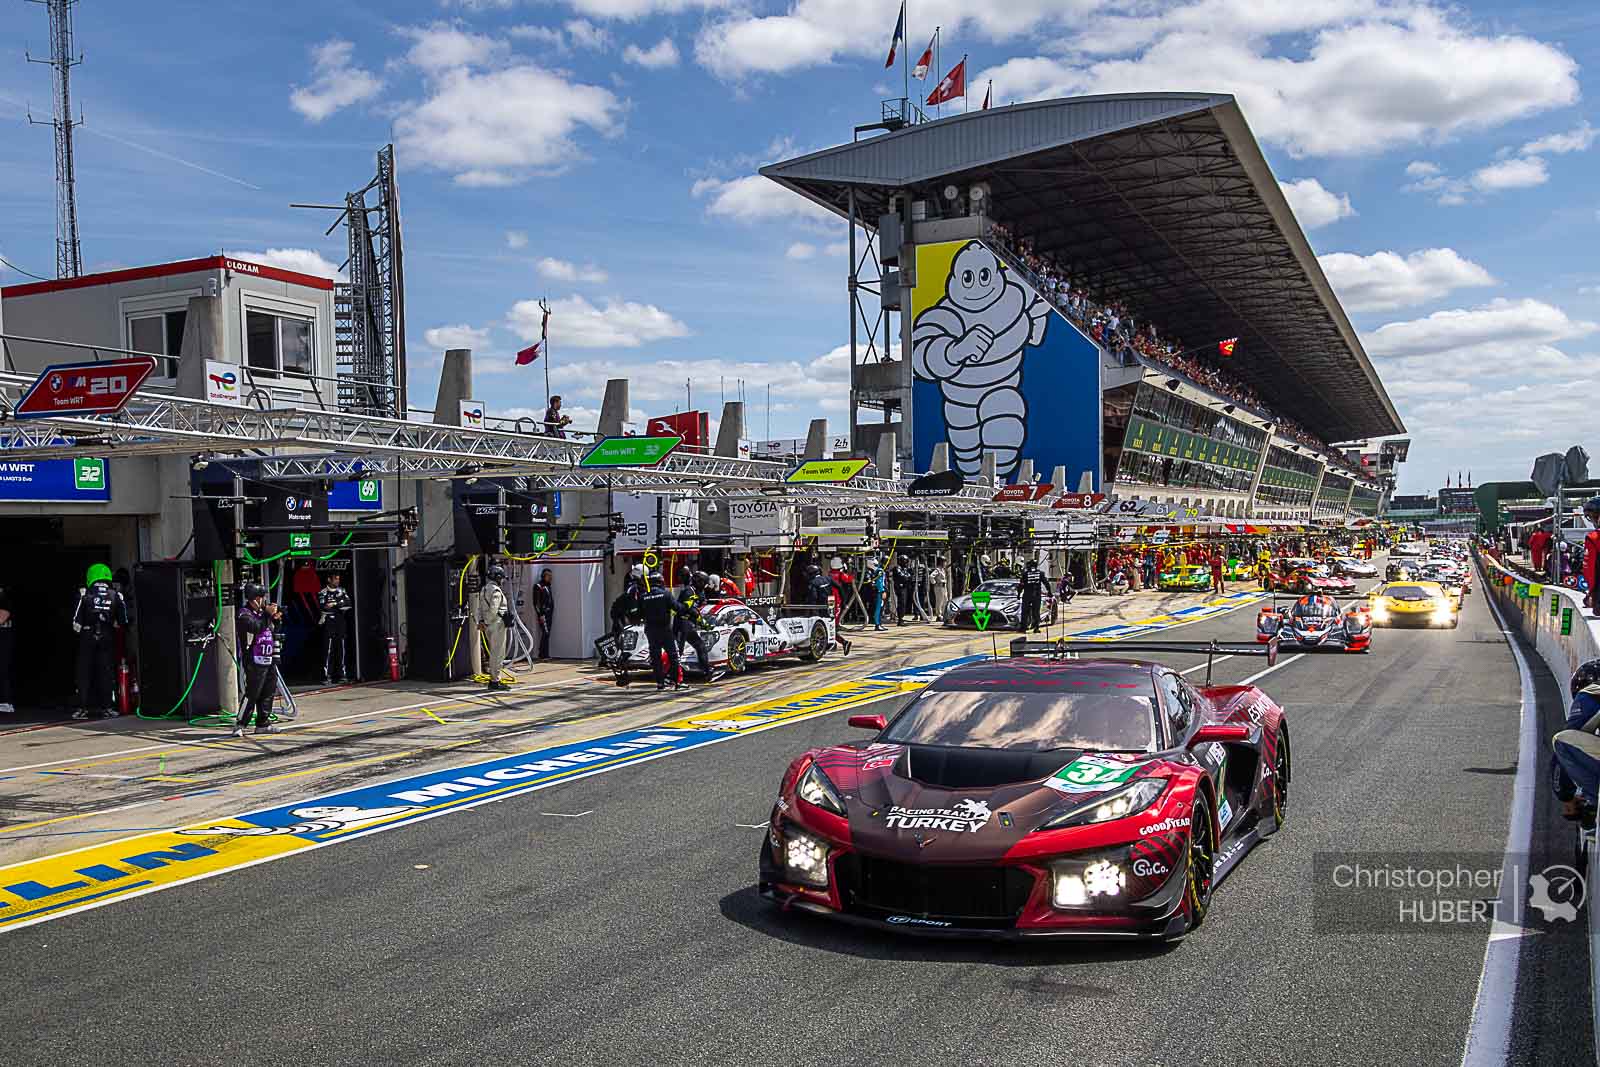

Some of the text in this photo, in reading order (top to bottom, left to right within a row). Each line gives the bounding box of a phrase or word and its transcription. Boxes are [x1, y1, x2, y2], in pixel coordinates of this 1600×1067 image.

[232, 261, 259, 273] LOXAM
[90, 376, 128, 395] 20
[54, 396, 84, 406] Team WRT
[602, 448, 619, 456] Team
[620, 447, 637, 456] WRT
[9, 463, 35, 472] WRT
[79, 466, 100, 482] 32
[819, 467, 833, 475] WRT
[841, 466, 851, 475] 69
[362, 480, 375, 497] 69
[1028, 485, 1038, 500] 7
[731, 502, 778, 513] TOYOTA
[1083, 494, 1092, 508] 8
[1120, 500, 1137, 513] 62
[819, 507, 862, 517] TOYOTA
[1184, 508, 1198, 518] 79
[622, 522, 648, 536] #28
[670, 517, 693, 528] IDEC
[746, 596, 777, 606] IDEC SPORT
[260, 644, 273, 655] 10
[743, 683, 896, 719] MICHELIN
[389, 732, 687, 803] MICHELIN
[1066, 764, 1122, 784] 34
[889, 805, 971, 819] RACING TEAM
[885, 815, 988, 833] TURKEY
[1139, 817, 1191, 836] GOODYEAR
[0, 842, 220, 907] LIN
[911, 918, 952, 926] SPORT
